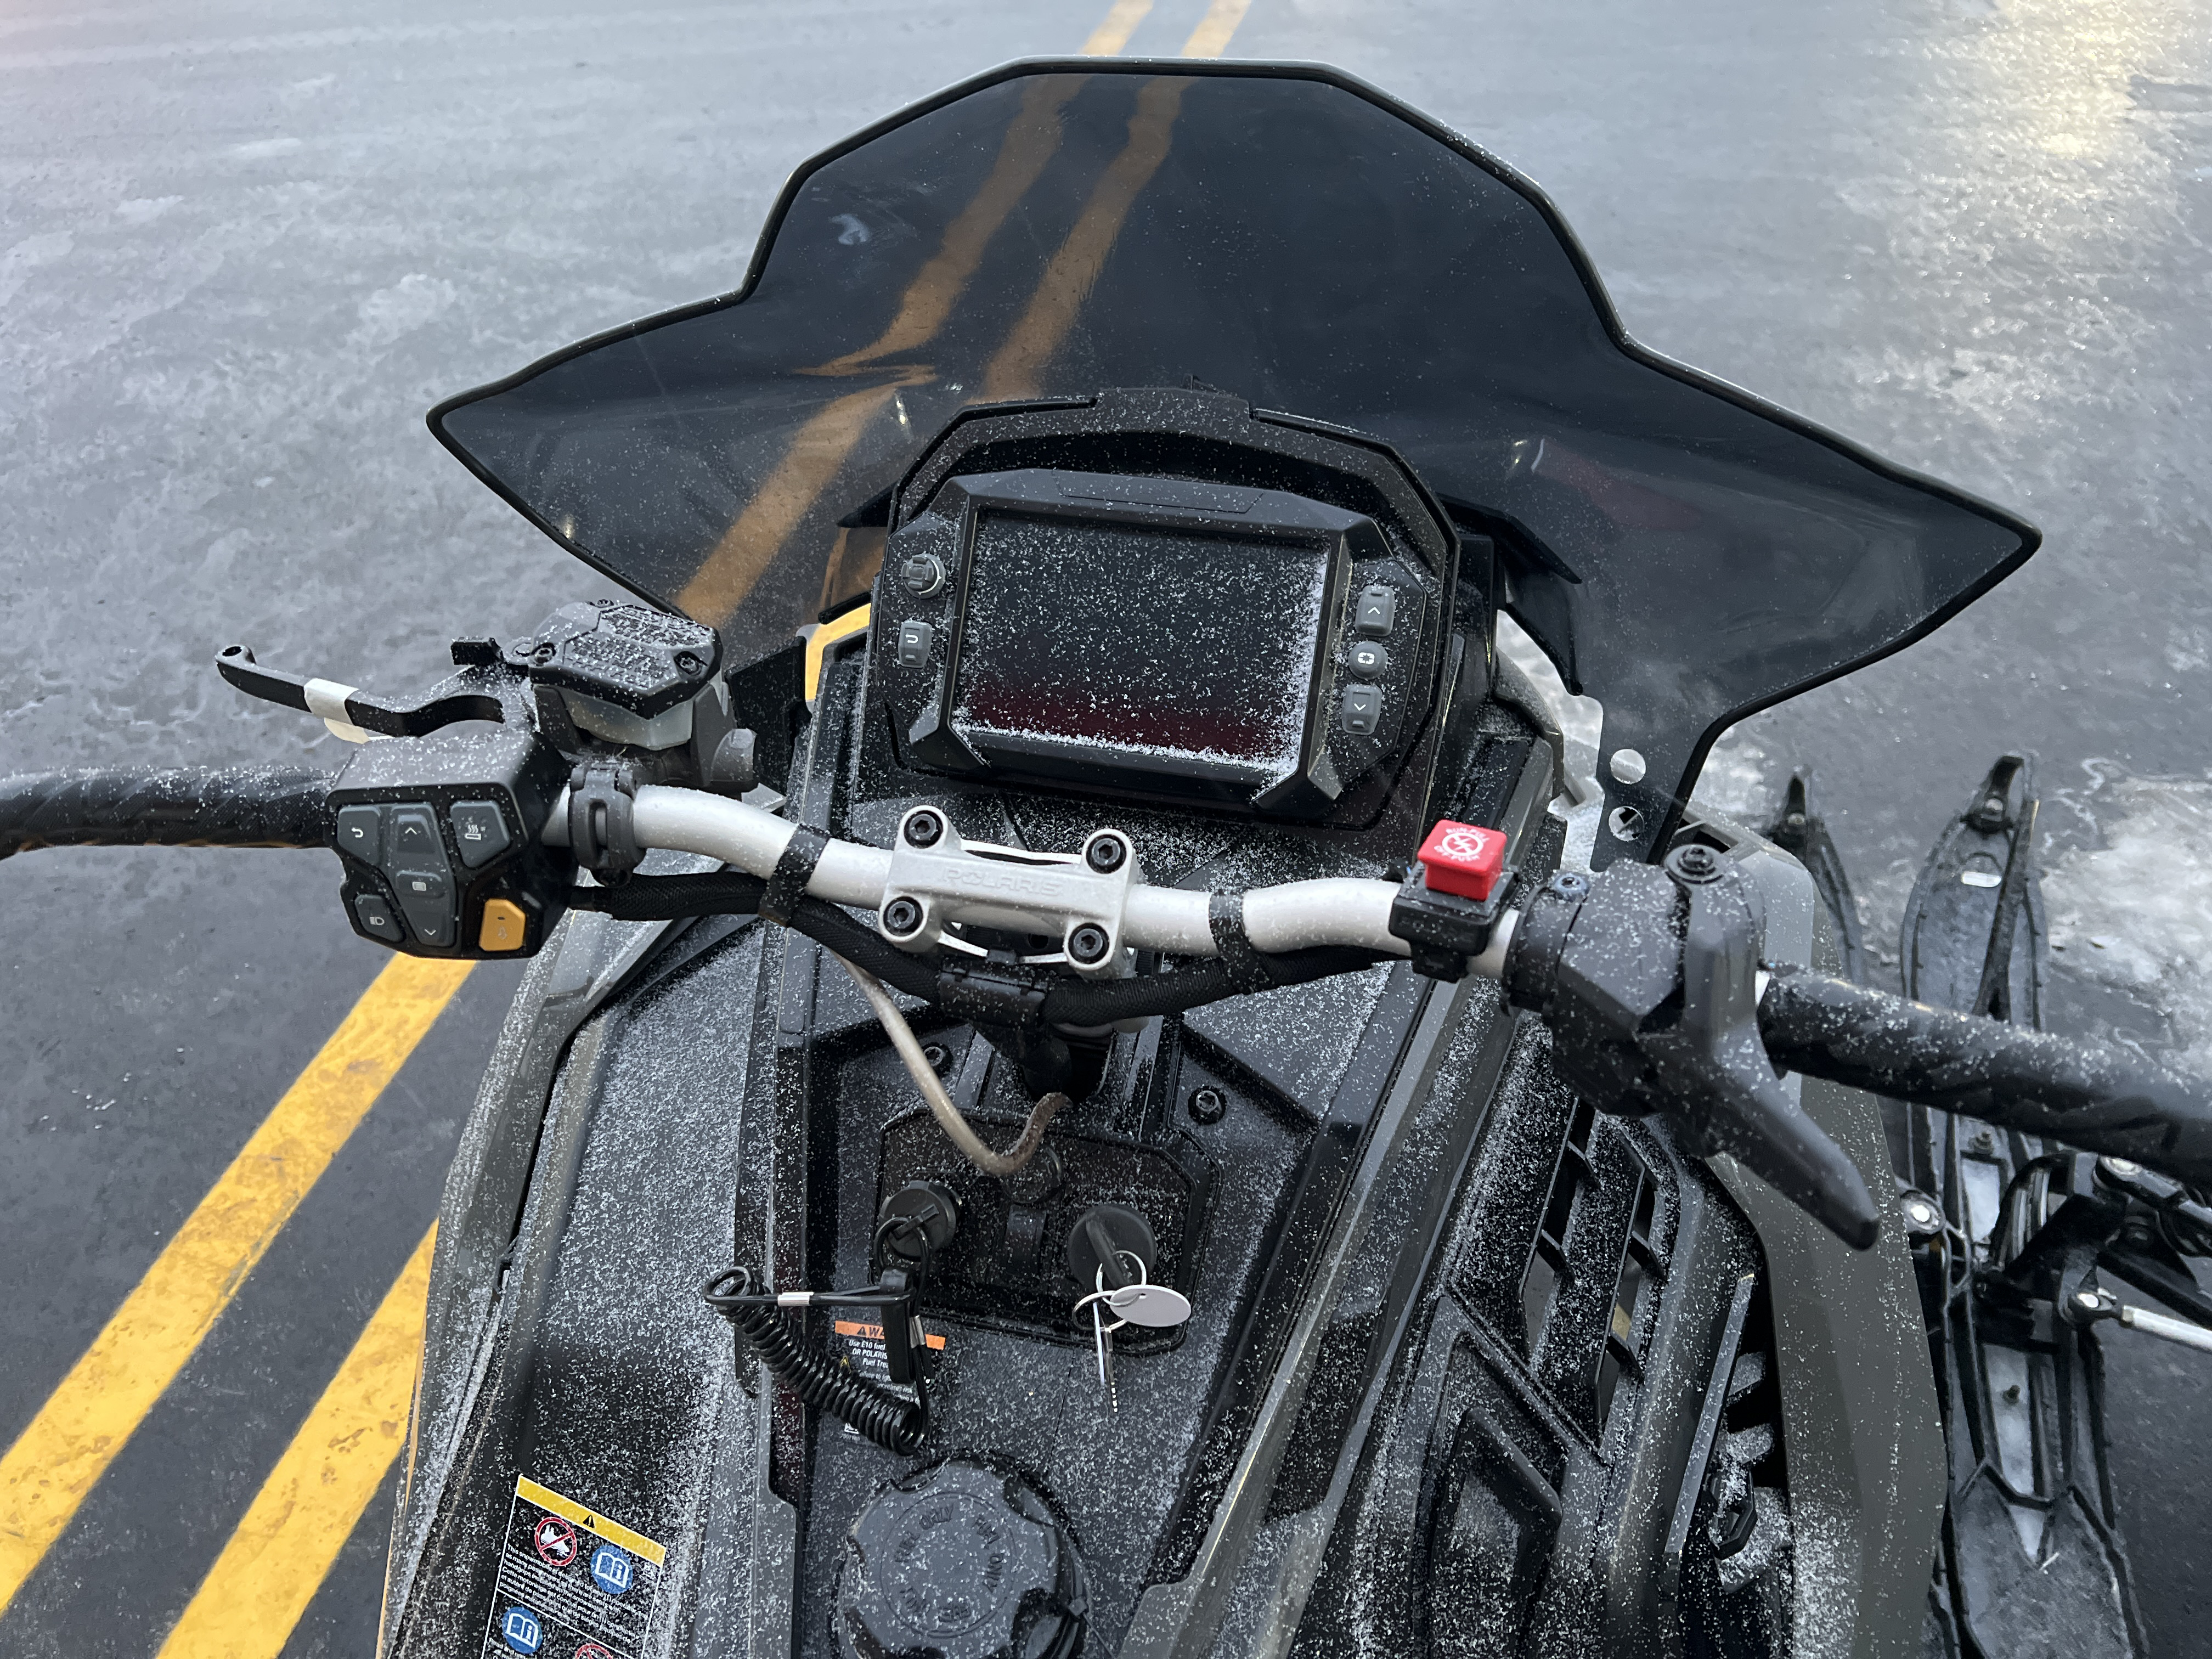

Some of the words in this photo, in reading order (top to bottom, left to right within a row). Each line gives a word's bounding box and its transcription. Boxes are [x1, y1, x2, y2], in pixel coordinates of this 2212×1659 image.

[943, 866, 1063, 896] POLARIS
[862, 1349, 888, 1359] POLARIS
[862, 1358, 876, 1366] Fuel
[919, 1503, 954, 1530] ONLY
